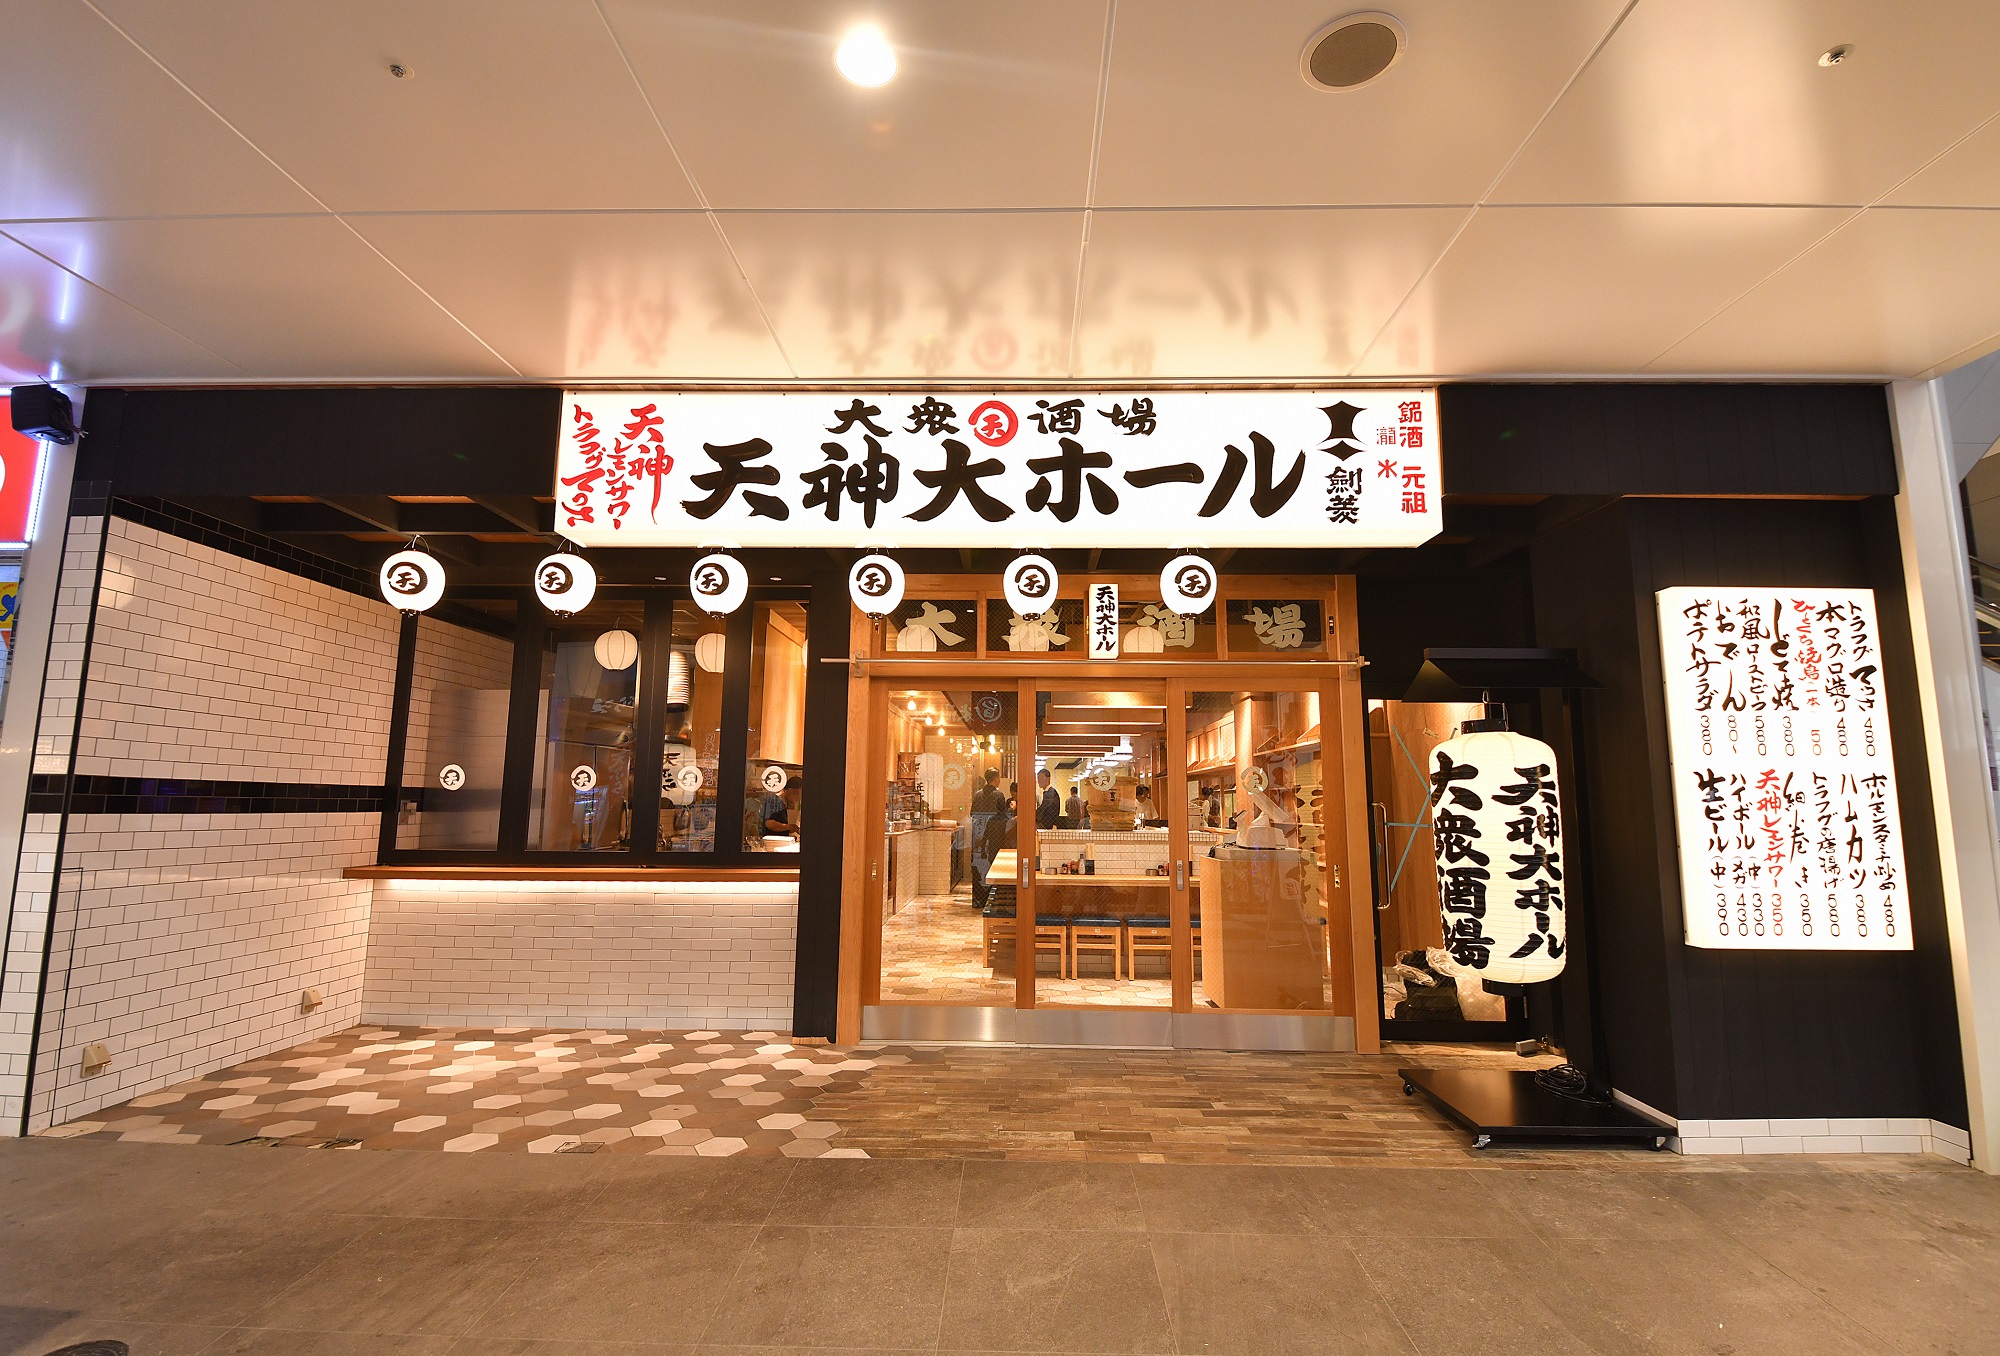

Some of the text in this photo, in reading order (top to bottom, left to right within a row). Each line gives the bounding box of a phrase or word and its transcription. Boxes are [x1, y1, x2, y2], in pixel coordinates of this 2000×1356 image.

[620, 403, 675, 525] 天神
[824, 396, 961, 437] 大衆
[1026, 397, 1158, 437] 酒場
[1398, 401, 1427, 513] 銘酒 元祖
[680, 431, 1306, 527] 天神大ホール
[1095, 586, 1117, 651] 天神大ホール
[1714, 598, 1747, 712] おでん
[1682, 597, 1722, 757] ポテトサラダ 380
[1735, 596, 1771, 757] 和風ローストビーフ 580
[1815, 598, 1851, 757] 本マグロ造り 480
[1780, 714, 1796, 757] 380
[1809, 726, 1823, 757] 50
[1862, 715, 1877, 757] 480
[1430, 750, 1496, 970] 大衆酒場
[1491, 764, 1566, 959] 天神大ホール
[1730, 772, 1755, 851] ハイボール
[1752, 892, 1766, 937] 330
[1811, 770, 1846, 938] トラフグの唐揚げ 580
[1840, 772, 1869, 938] ハムカツ 380
[1860, 771, 1898, 938] ホルモンスタミナ炒め 480
[1716, 891, 1731, 937] 390
[1737, 892, 1749, 937] 430
[1770, 891, 1784, 938] 350
[1798, 892, 1814, 938] 350
